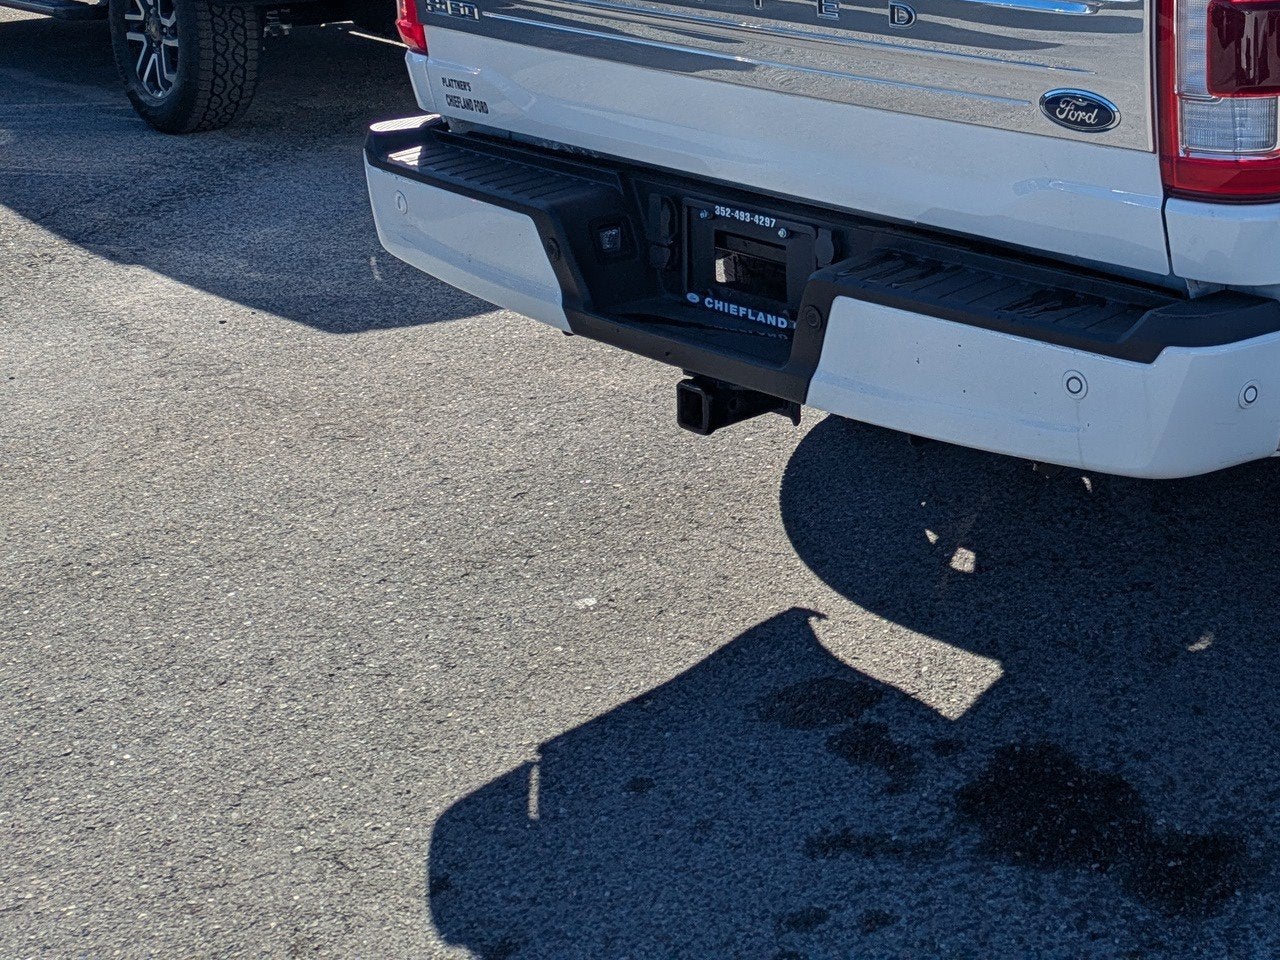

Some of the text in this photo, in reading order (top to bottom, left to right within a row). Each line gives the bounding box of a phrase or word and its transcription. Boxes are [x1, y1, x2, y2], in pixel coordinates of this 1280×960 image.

[445, 93, 489, 115] CHIEFLAND FORD
[1055, 97, 1099, 125] Ford
[714, 205, 776, 228] 352-493-4297
[704, 296, 788, 329] CHIEFLAND
